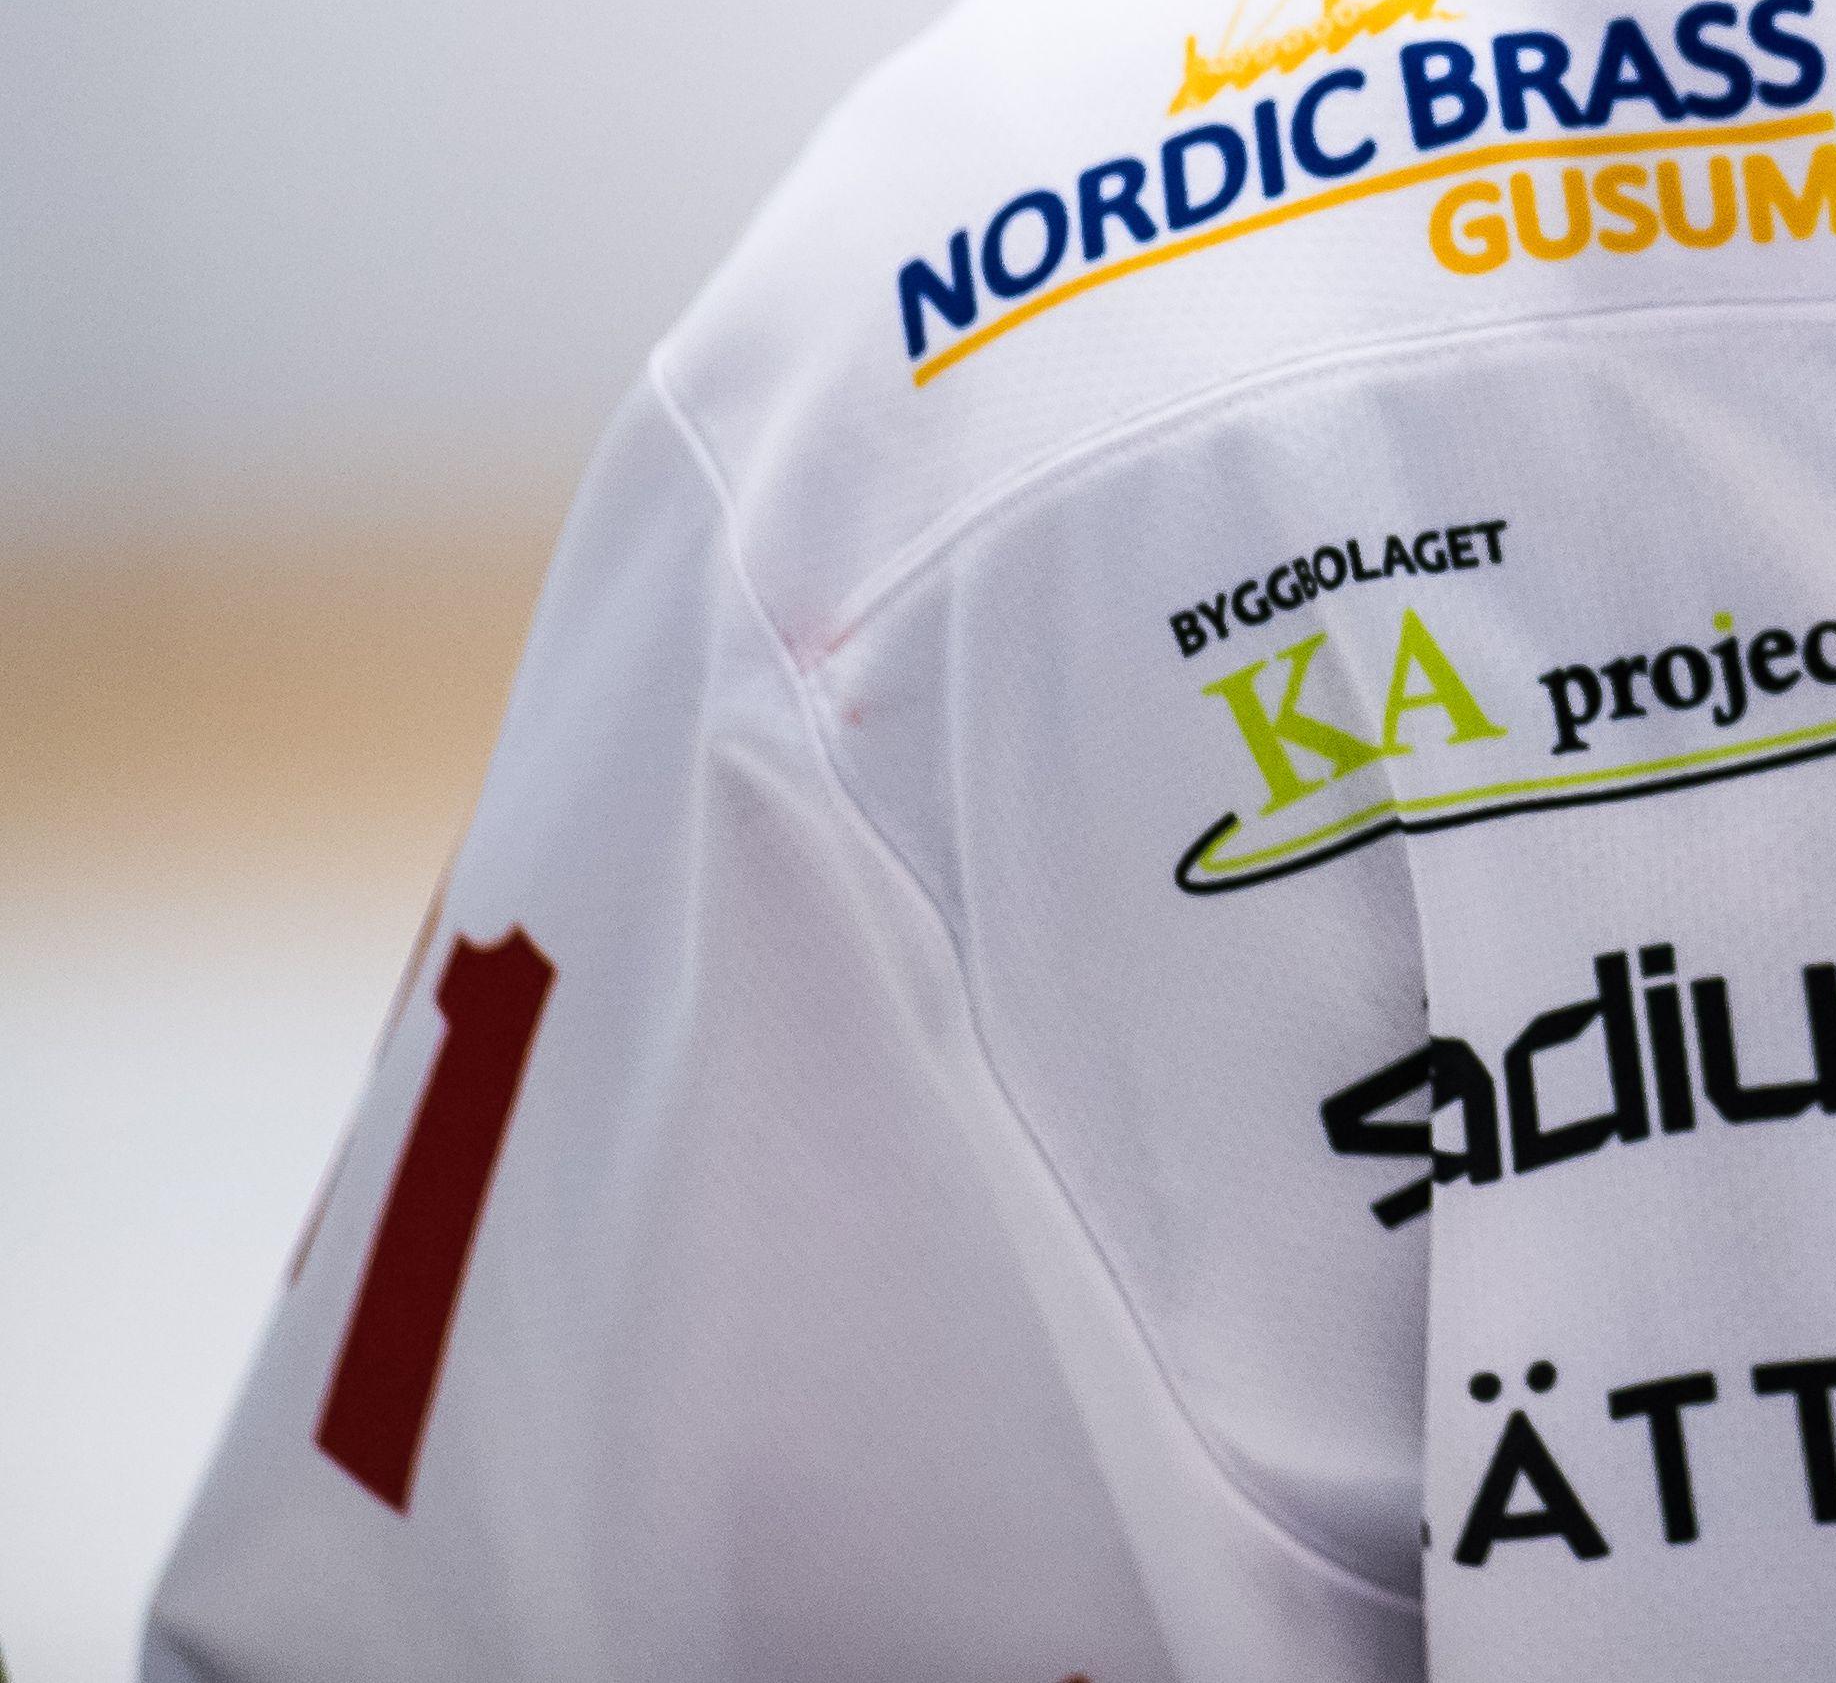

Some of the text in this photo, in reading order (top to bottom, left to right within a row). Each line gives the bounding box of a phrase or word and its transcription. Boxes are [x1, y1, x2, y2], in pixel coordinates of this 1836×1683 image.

[897, 67, 1378, 360] NORDIC
[1169, 518, 1508, 658] BYGGBOLAGET
[1202, 606, 1508, 817] KA
